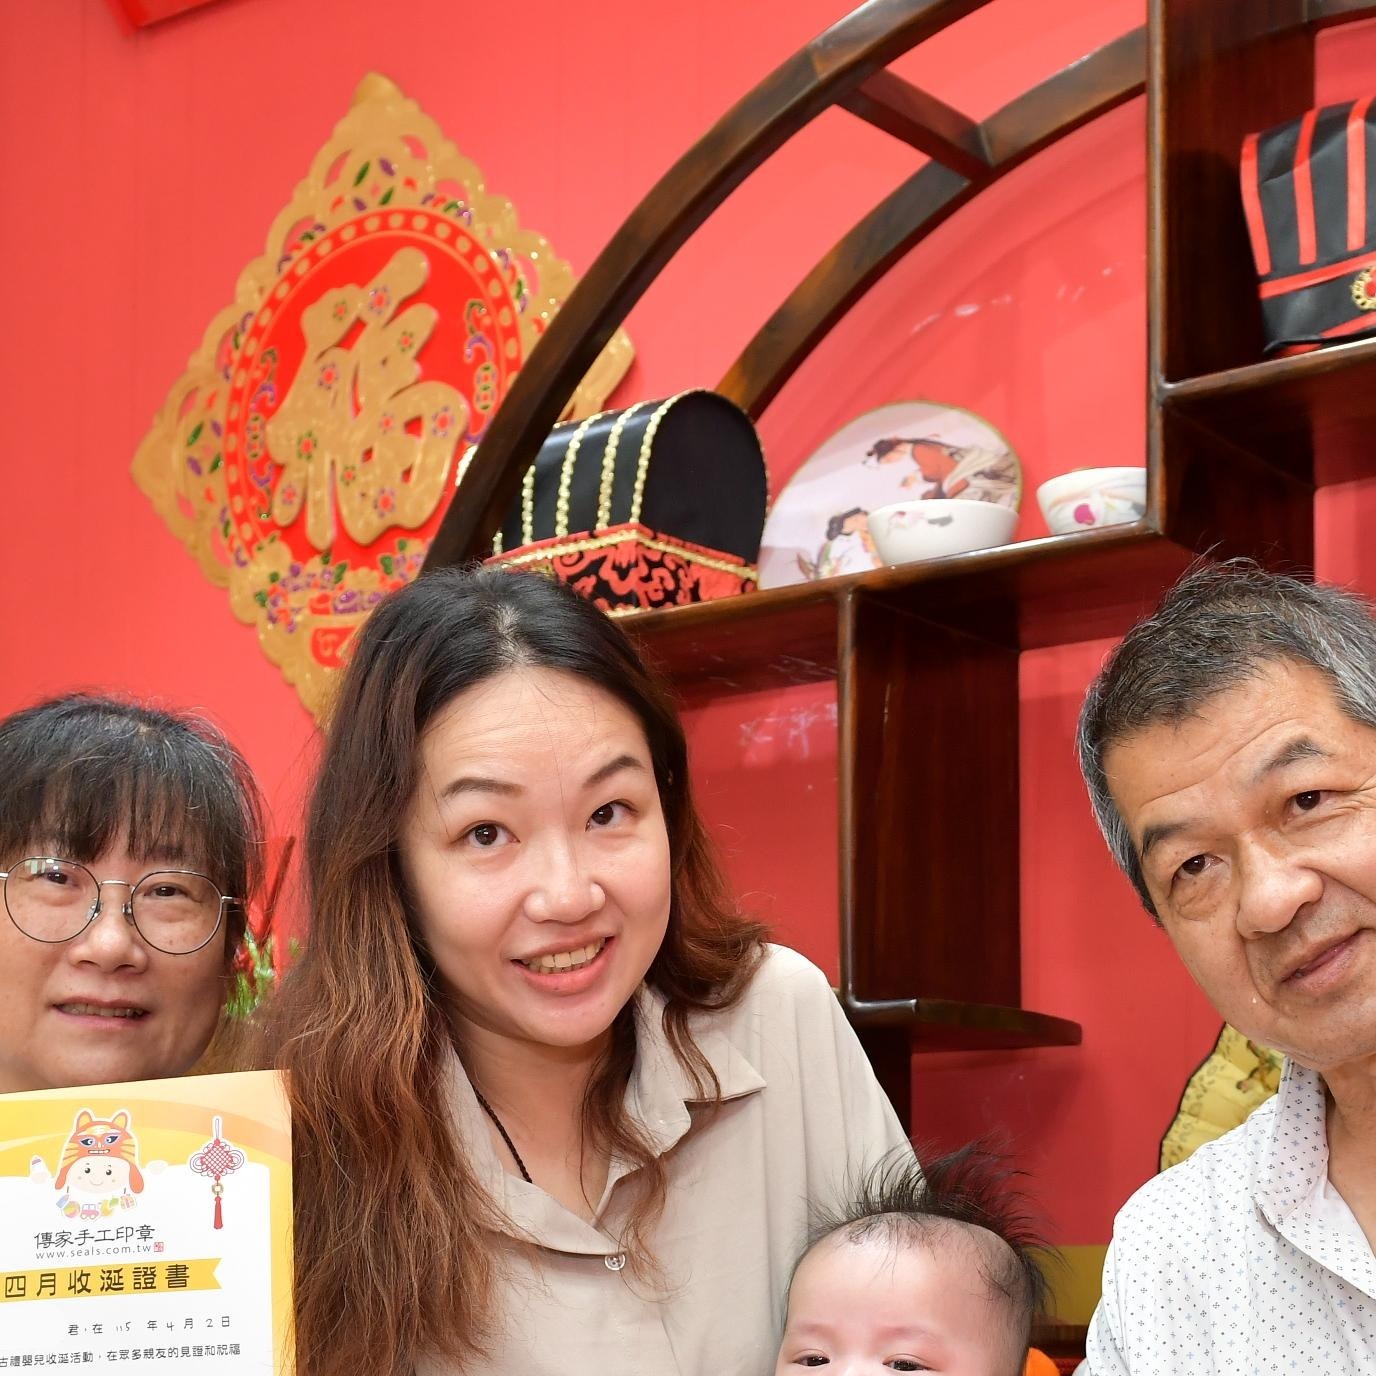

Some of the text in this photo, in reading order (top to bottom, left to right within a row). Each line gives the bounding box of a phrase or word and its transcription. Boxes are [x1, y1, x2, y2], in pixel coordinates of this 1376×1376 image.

[266, 246, 468, 551] 福
[34, 1224, 155, 1249] 傳家手工印章
[35, 1244, 151, 1260] www.seals.com.tw
[5, 1263, 190, 1298] 四月收涎證書
[146, 1320, 158, 1331] 年
[166, 1321, 175, 1332] 4
[183, 1317, 194, 1330] 月
[205, 1318, 214, 1328] 2
[221, 1315, 230, 1328] 日
